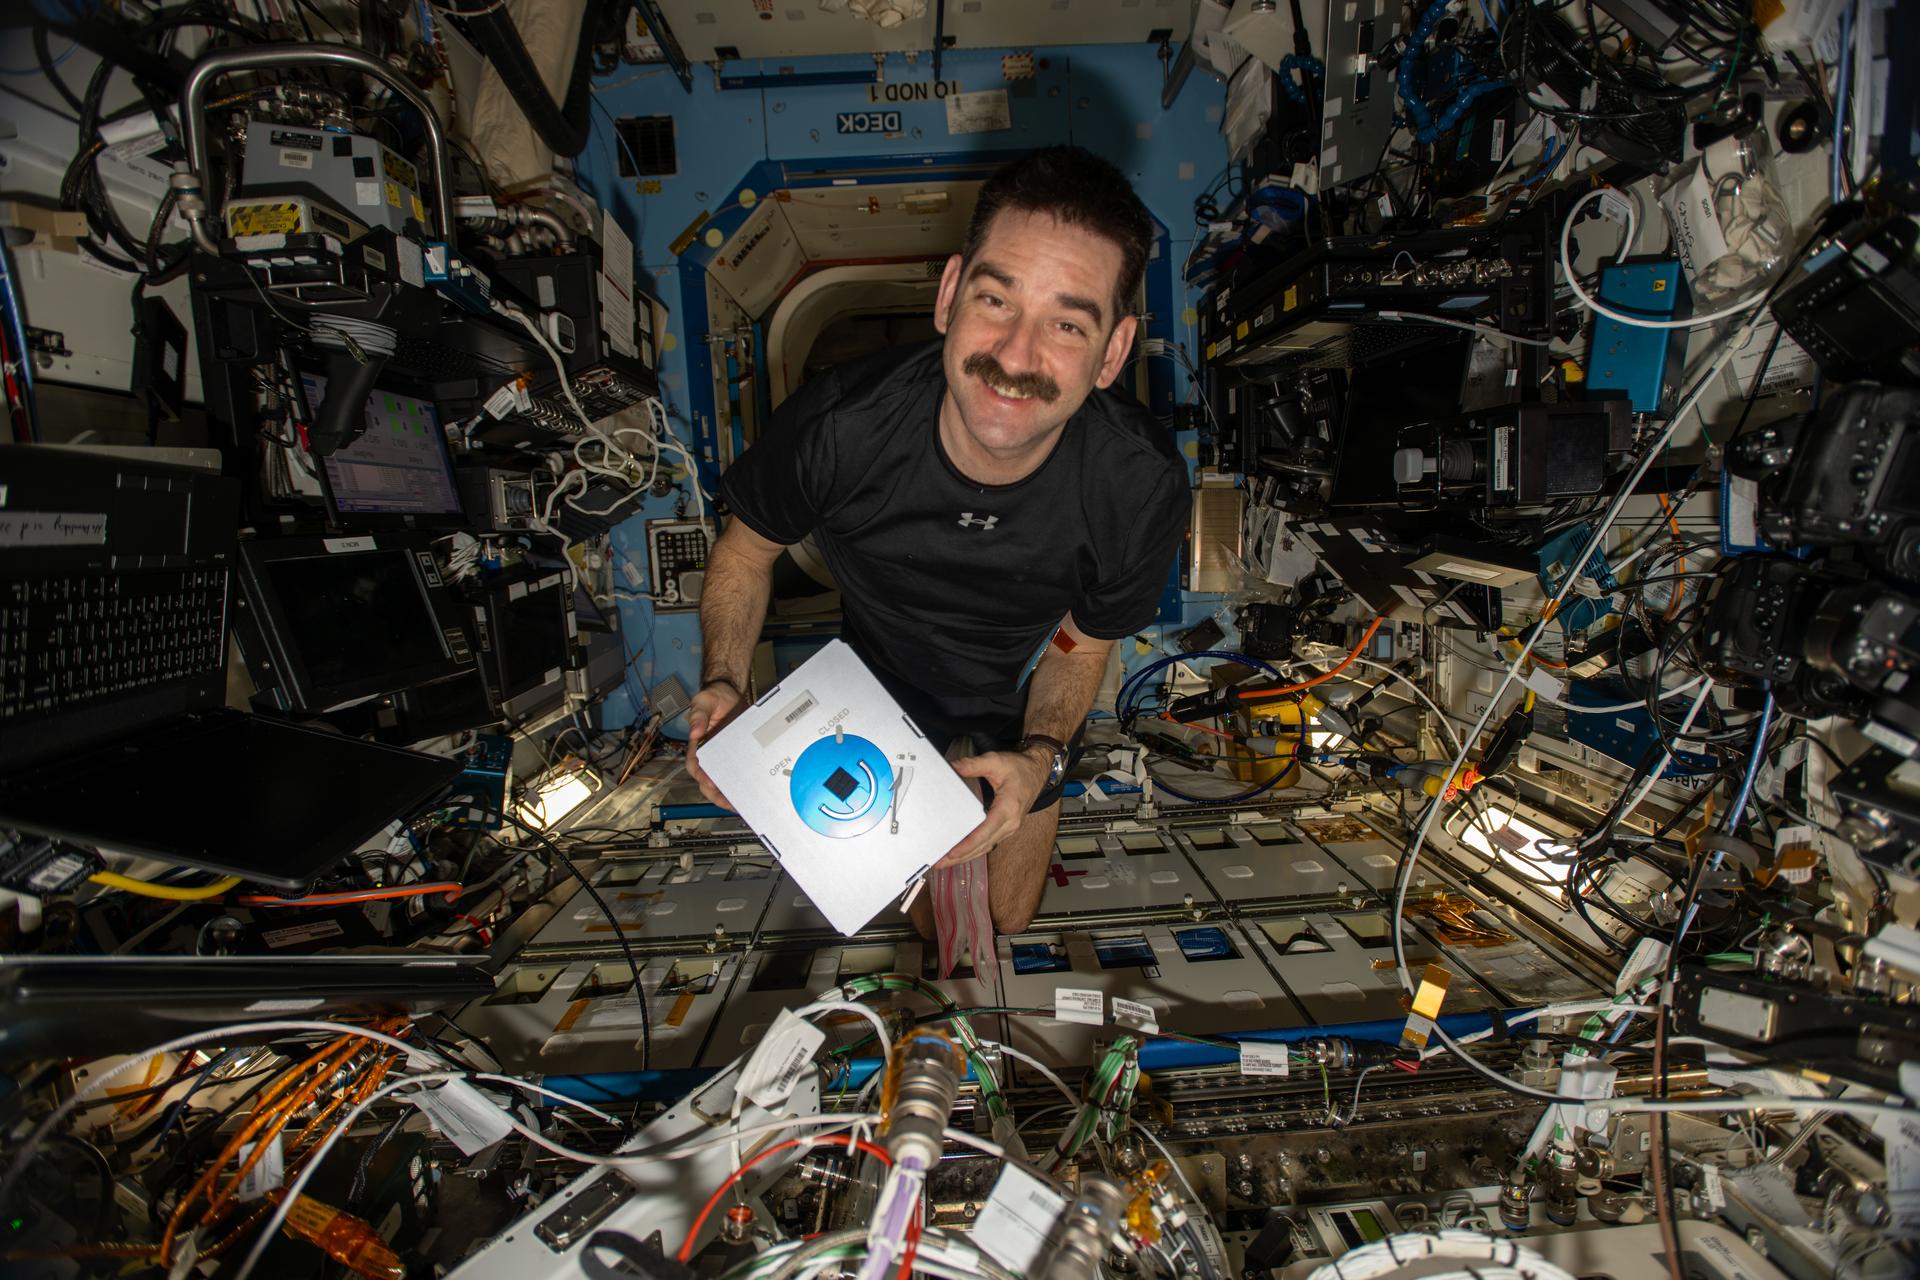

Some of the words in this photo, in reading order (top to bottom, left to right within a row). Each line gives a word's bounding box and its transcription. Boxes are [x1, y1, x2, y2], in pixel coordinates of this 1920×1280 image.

[870, 84, 878, 102] 1
[885, 83, 928, 101] NOD
[839, 113, 899, 132] DECK
[818, 707, 850, 735] CLOSED
[769, 757, 793, 776] OPEN
